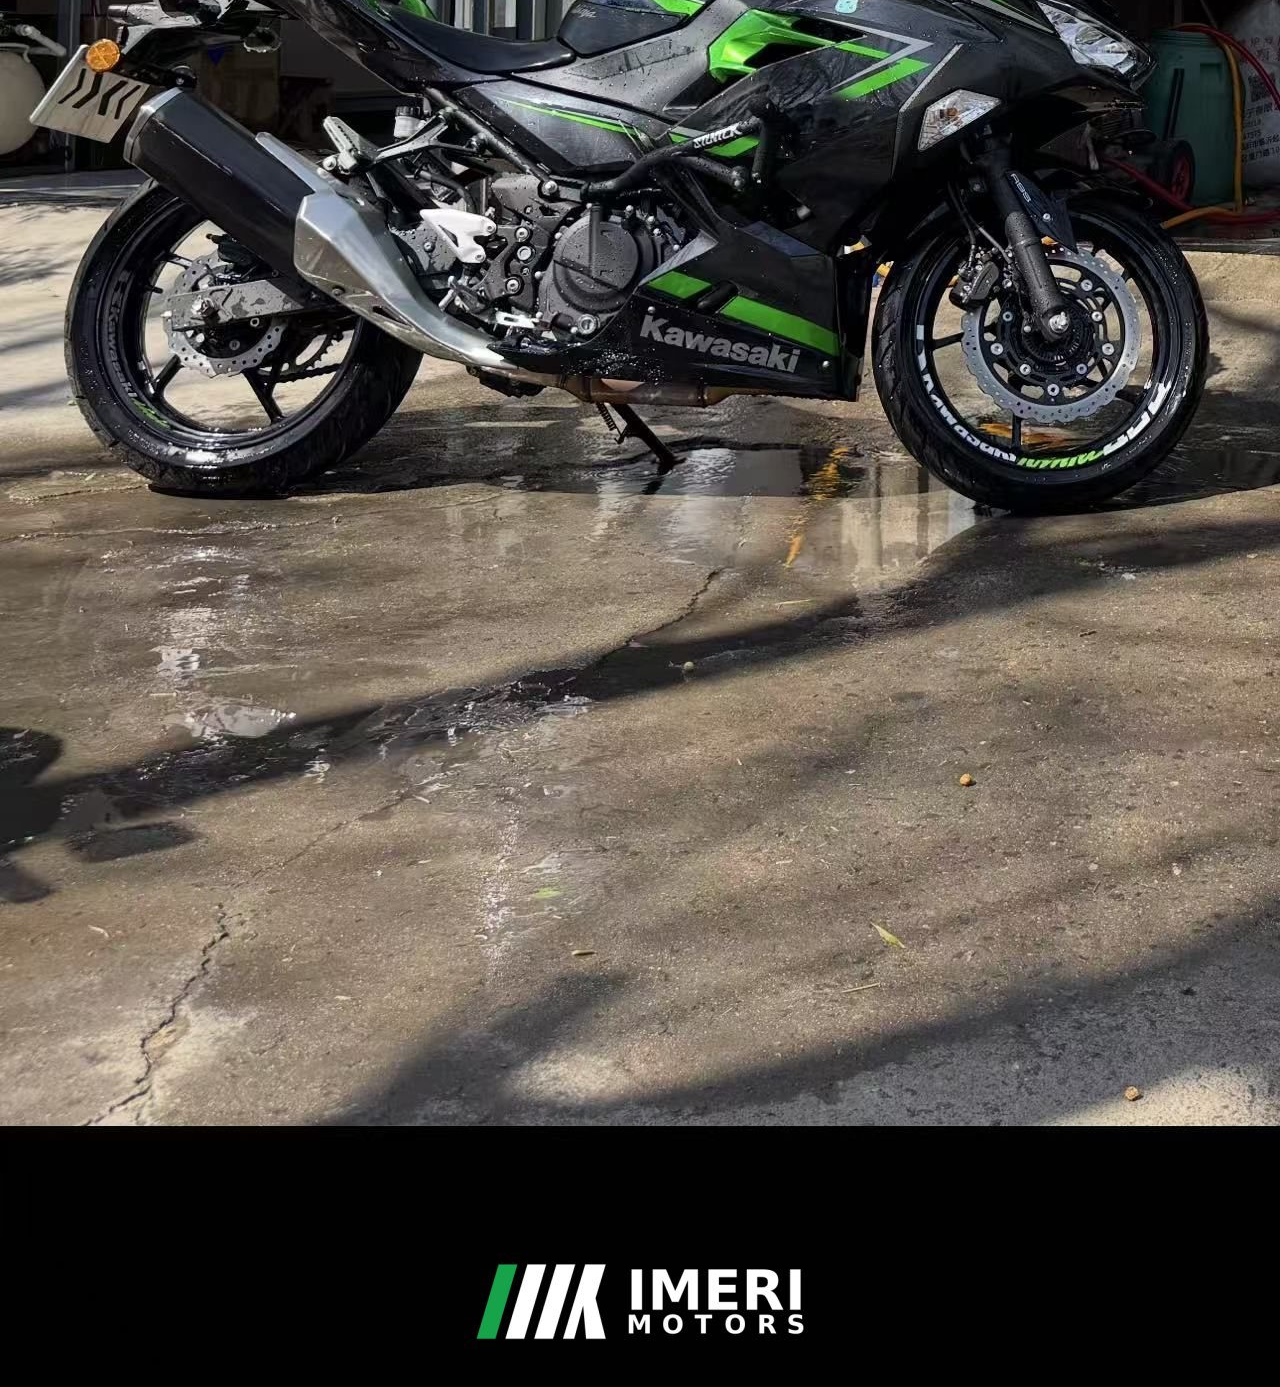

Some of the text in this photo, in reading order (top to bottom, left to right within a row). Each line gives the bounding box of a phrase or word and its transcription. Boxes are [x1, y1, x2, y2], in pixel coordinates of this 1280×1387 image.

[1010, 173, 1032, 203] ABS
[107, 312, 138, 398] Kawasaki
[639, 314, 801, 374] Kawasaki
